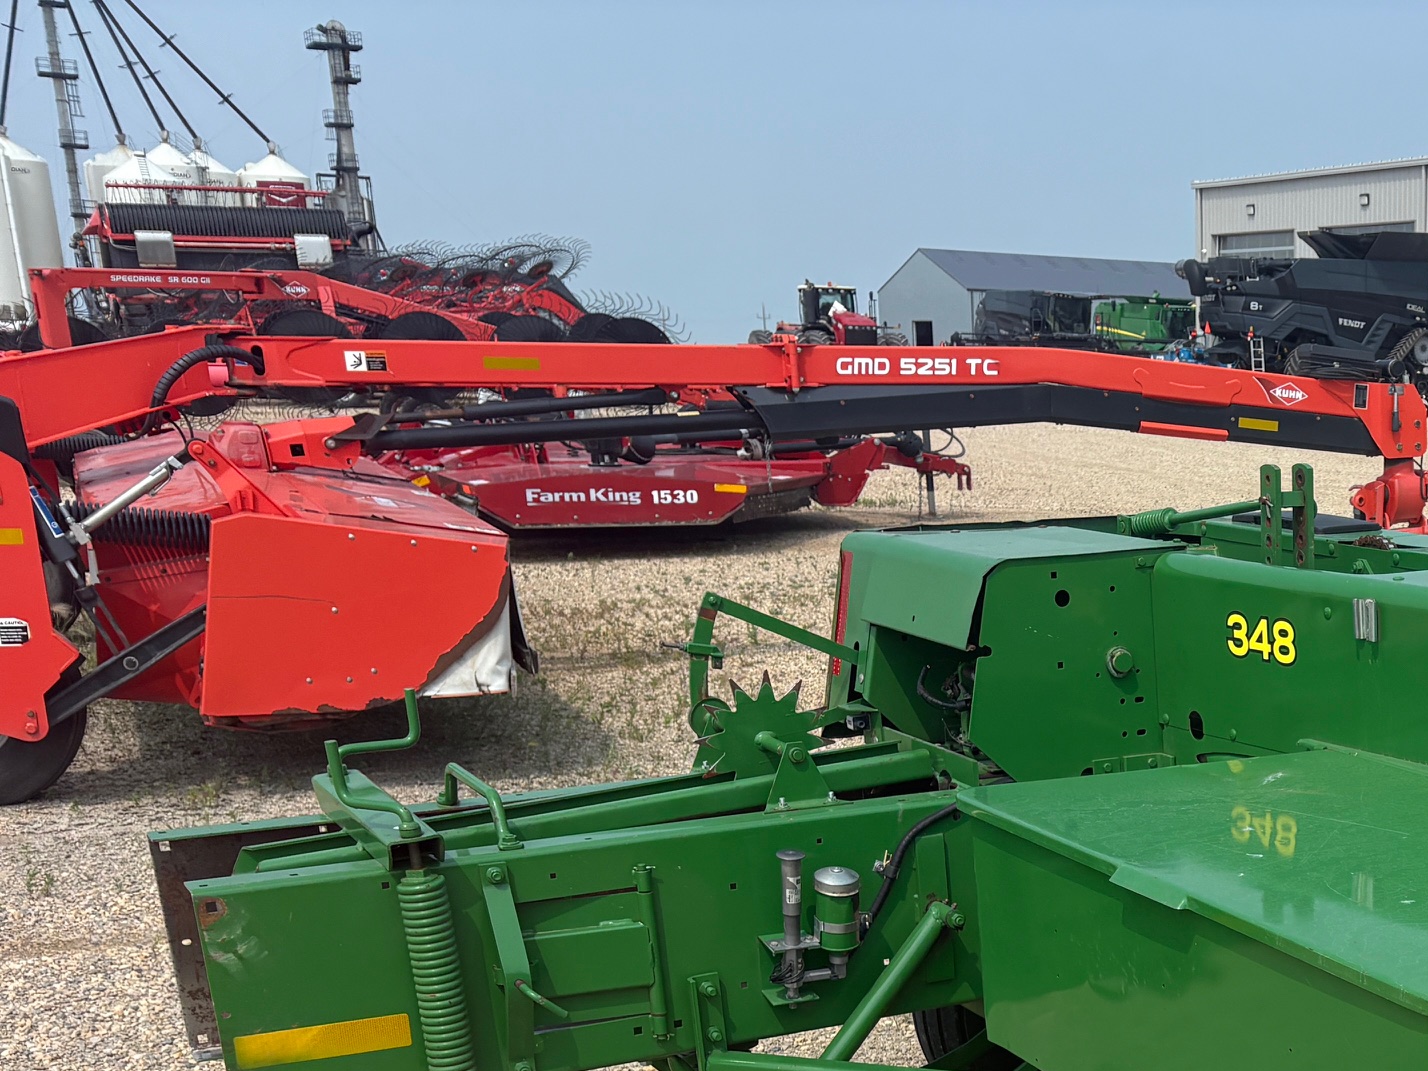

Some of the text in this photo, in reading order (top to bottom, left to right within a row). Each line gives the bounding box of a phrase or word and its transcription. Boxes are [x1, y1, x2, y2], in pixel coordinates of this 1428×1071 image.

[110, 274, 162, 283] SPEEDRAKE
[181, 276, 199, 284] 600
[286, 285, 307, 294] KUHN
[1406, 303, 1426, 313] IDEAL
[1338, 317, 1367, 329] FENDT
[836, 357, 1000, 375] GMD 5251 TC
[1275, 387, 1304, 400] KUHN
[525, 487, 699, 505] Farm King 1530
[1226, 612, 1298, 666] 348
